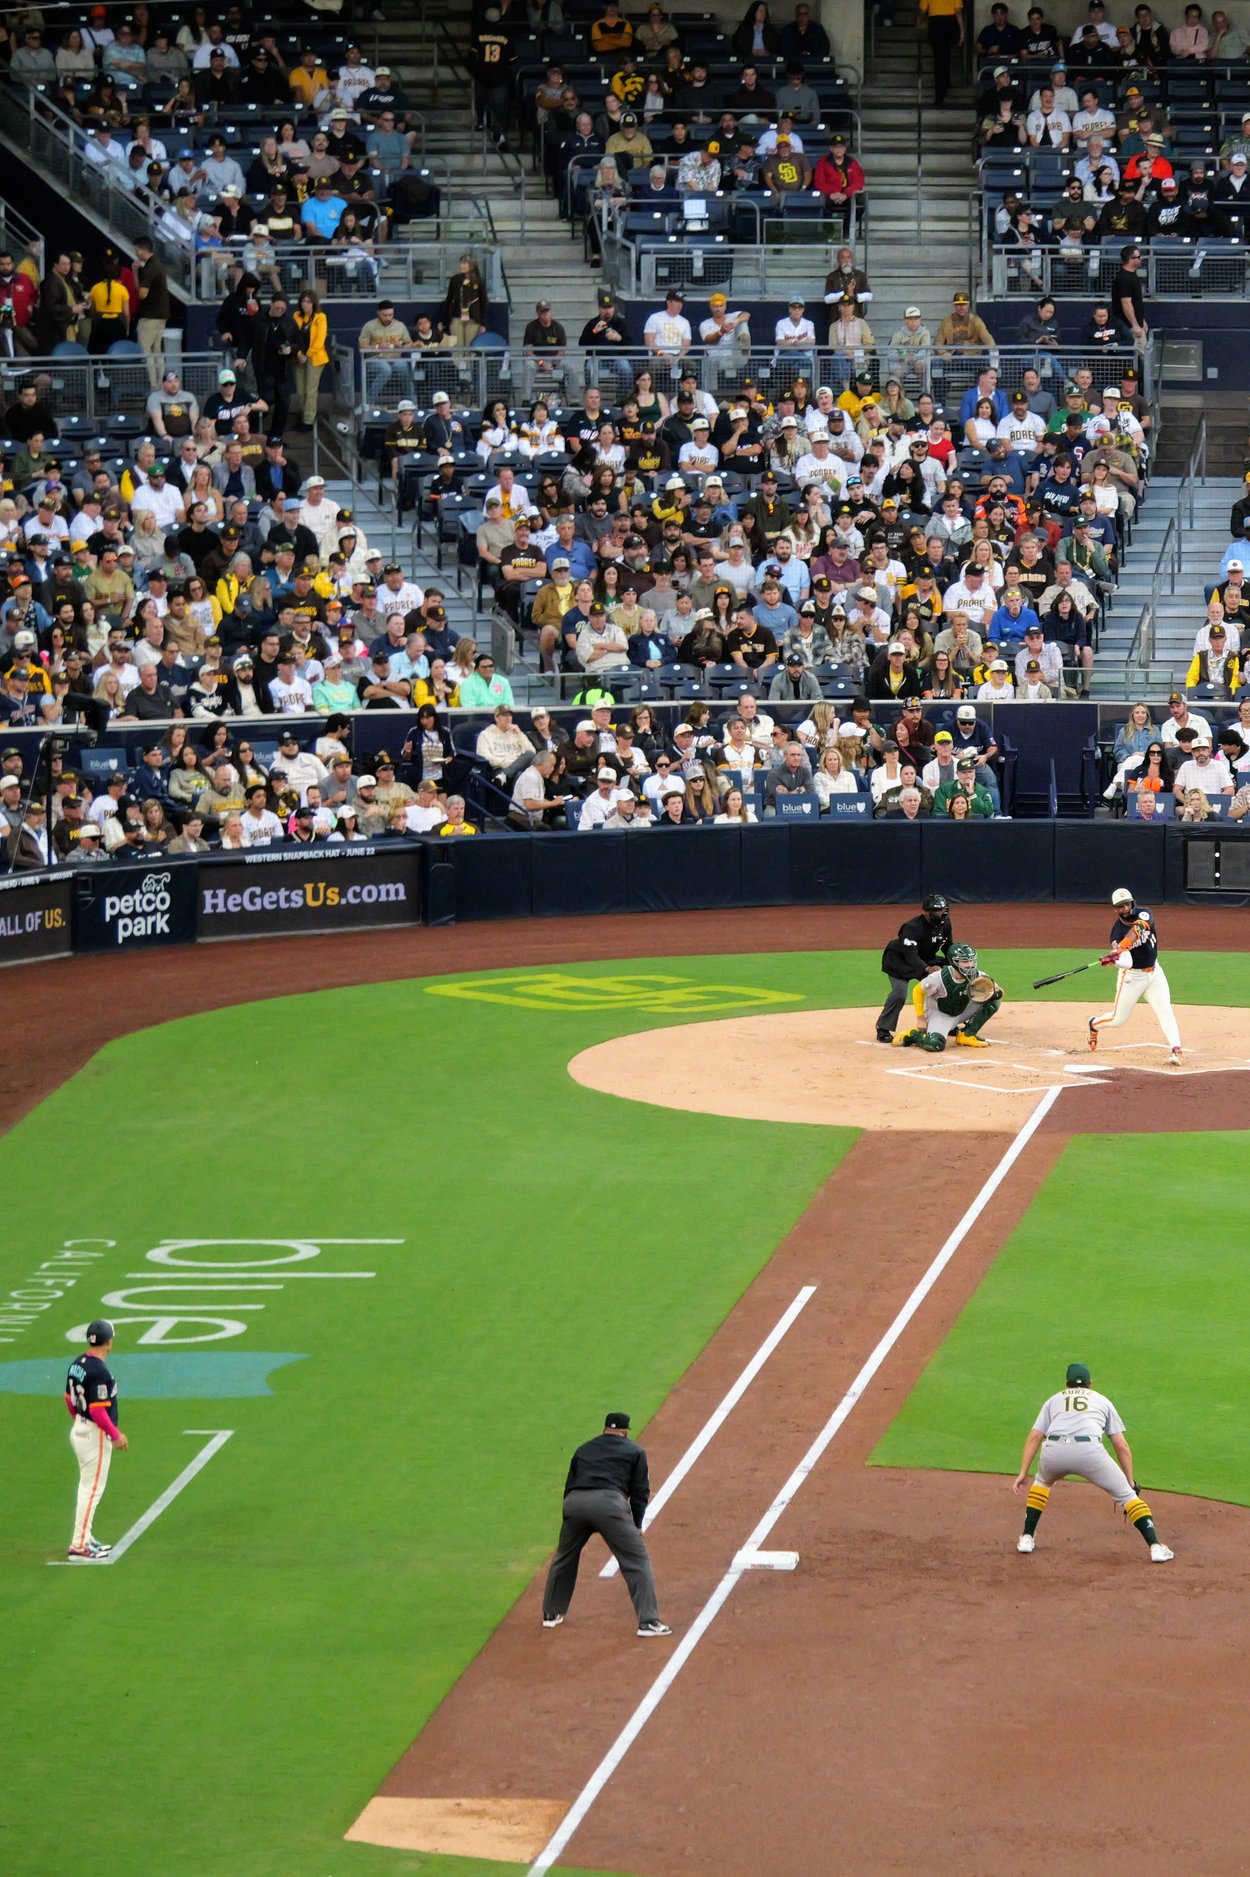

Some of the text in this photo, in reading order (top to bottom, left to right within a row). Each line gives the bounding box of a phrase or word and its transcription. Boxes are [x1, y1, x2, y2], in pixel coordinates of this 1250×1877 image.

[384, 600, 415, 614] PADRES
[782, 802, 803, 813] blue
[837, 801, 857, 812] blue
[245, 854, 282, 864] WESTERN
[283, 850, 324, 861] SNAPBACK
[325, 849, 340, 858] HAT
[346, 848, 365, 857] JUNE
[366, 847, 375, 855] 22
[105, 891, 171, 923] petco
[202, 881, 407, 915] HeGetsUs.com
[0, 908, 67, 937] ALL OF US.
[117, 912, 171, 944] park
[0, 1238, 117, 1343] CALIFORNI
[65, 1238, 405, 1345] blue
[1064, 1396, 1089, 1412] 16
